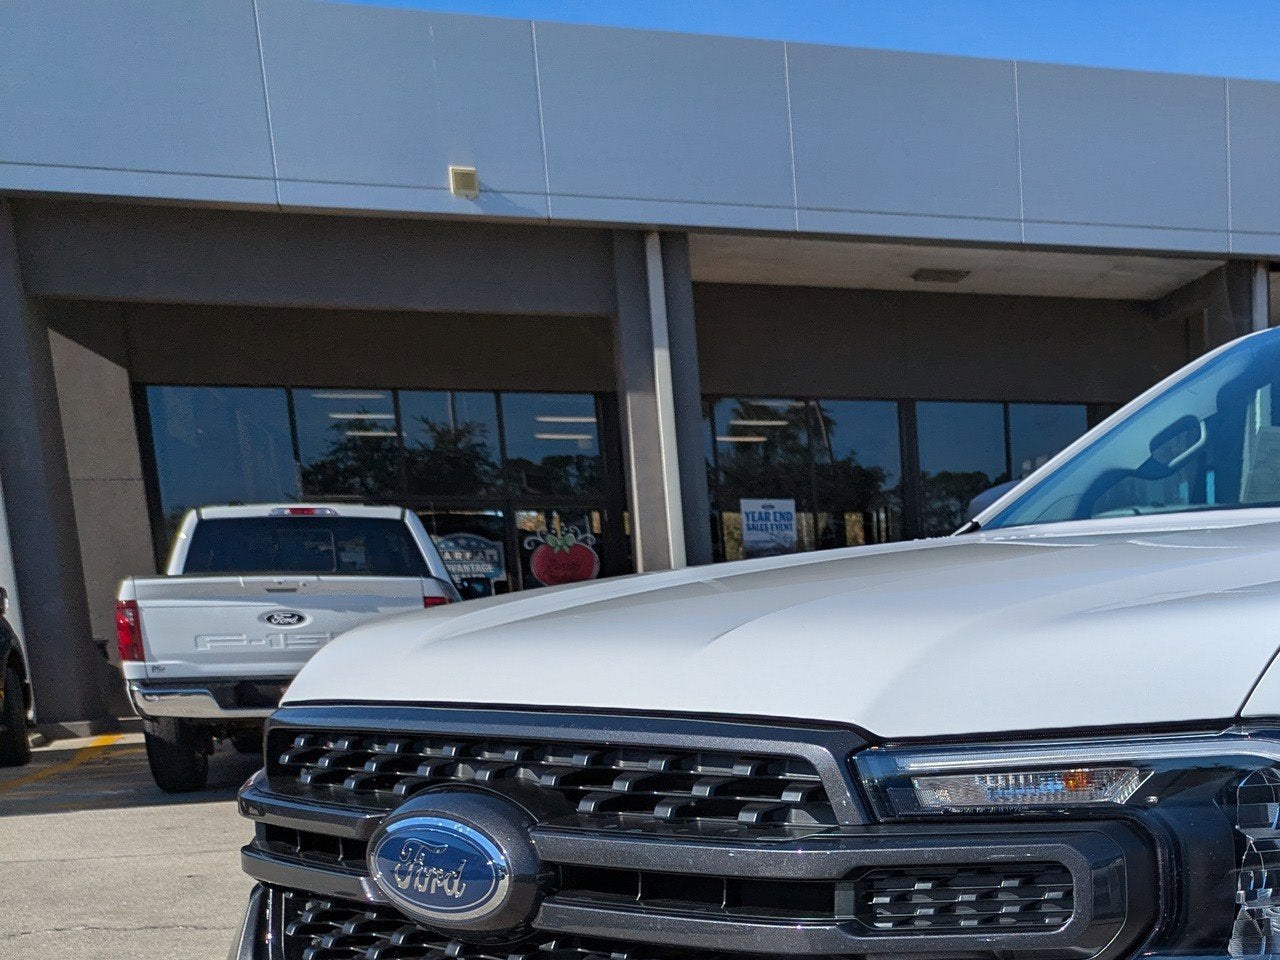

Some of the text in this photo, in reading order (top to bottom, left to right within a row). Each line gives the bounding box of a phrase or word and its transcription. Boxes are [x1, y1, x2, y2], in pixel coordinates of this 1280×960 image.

[744, 510, 793, 522] YEAR END
[745, 523, 793, 532] SALES EVENT
[441, 550, 498, 561] ARFAX
[447, 563, 495, 573] DVANTAGE
[270, 611, 298, 625] Ford
[194, 632, 337, 651] F-15
[394, 838, 467, 899] Ford
